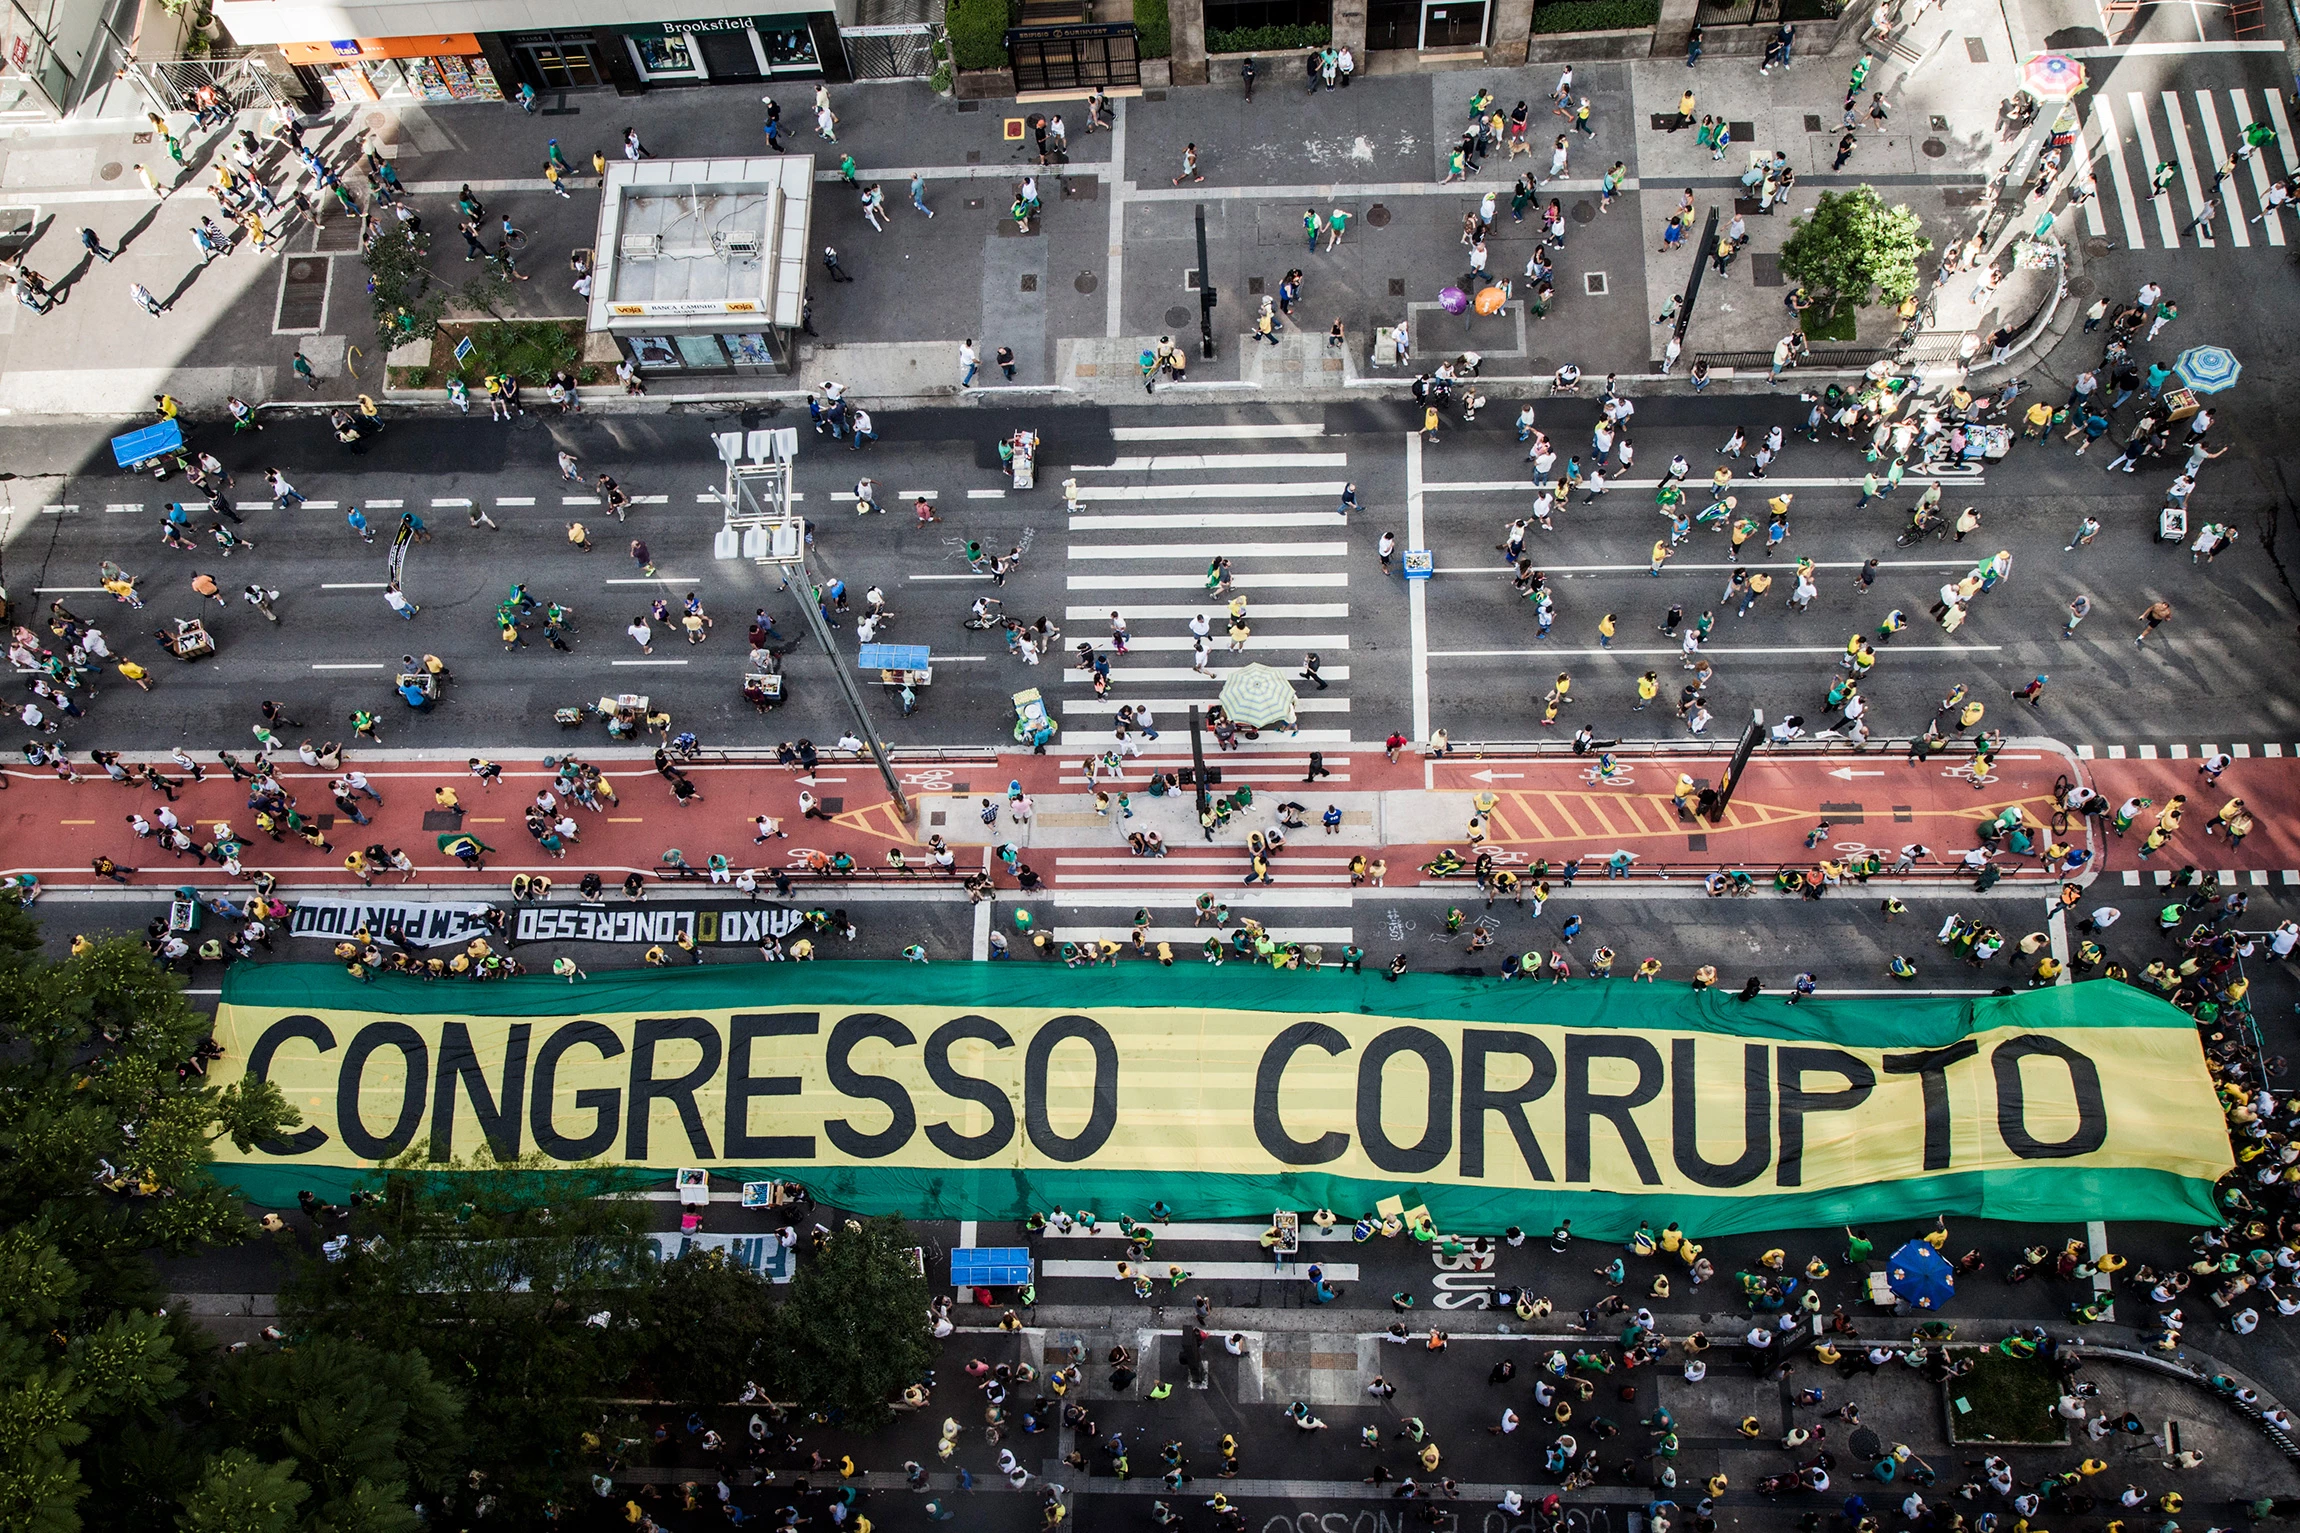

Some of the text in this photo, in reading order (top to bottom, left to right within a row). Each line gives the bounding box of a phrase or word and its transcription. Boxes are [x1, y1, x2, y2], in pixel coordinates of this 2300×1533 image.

[662, 16, 755, 34] Brooksfield
[617, 306, 642, 314] veja
[728, 303, 753, 312] veja
[296, 906, 428, 939] PARTIDO
[516, 909, 696, 942] CONGRESSO
[698, 911, 718, 943] O
[246, 1012, 2108, 1187] CONGRESSO CORRUPTO
